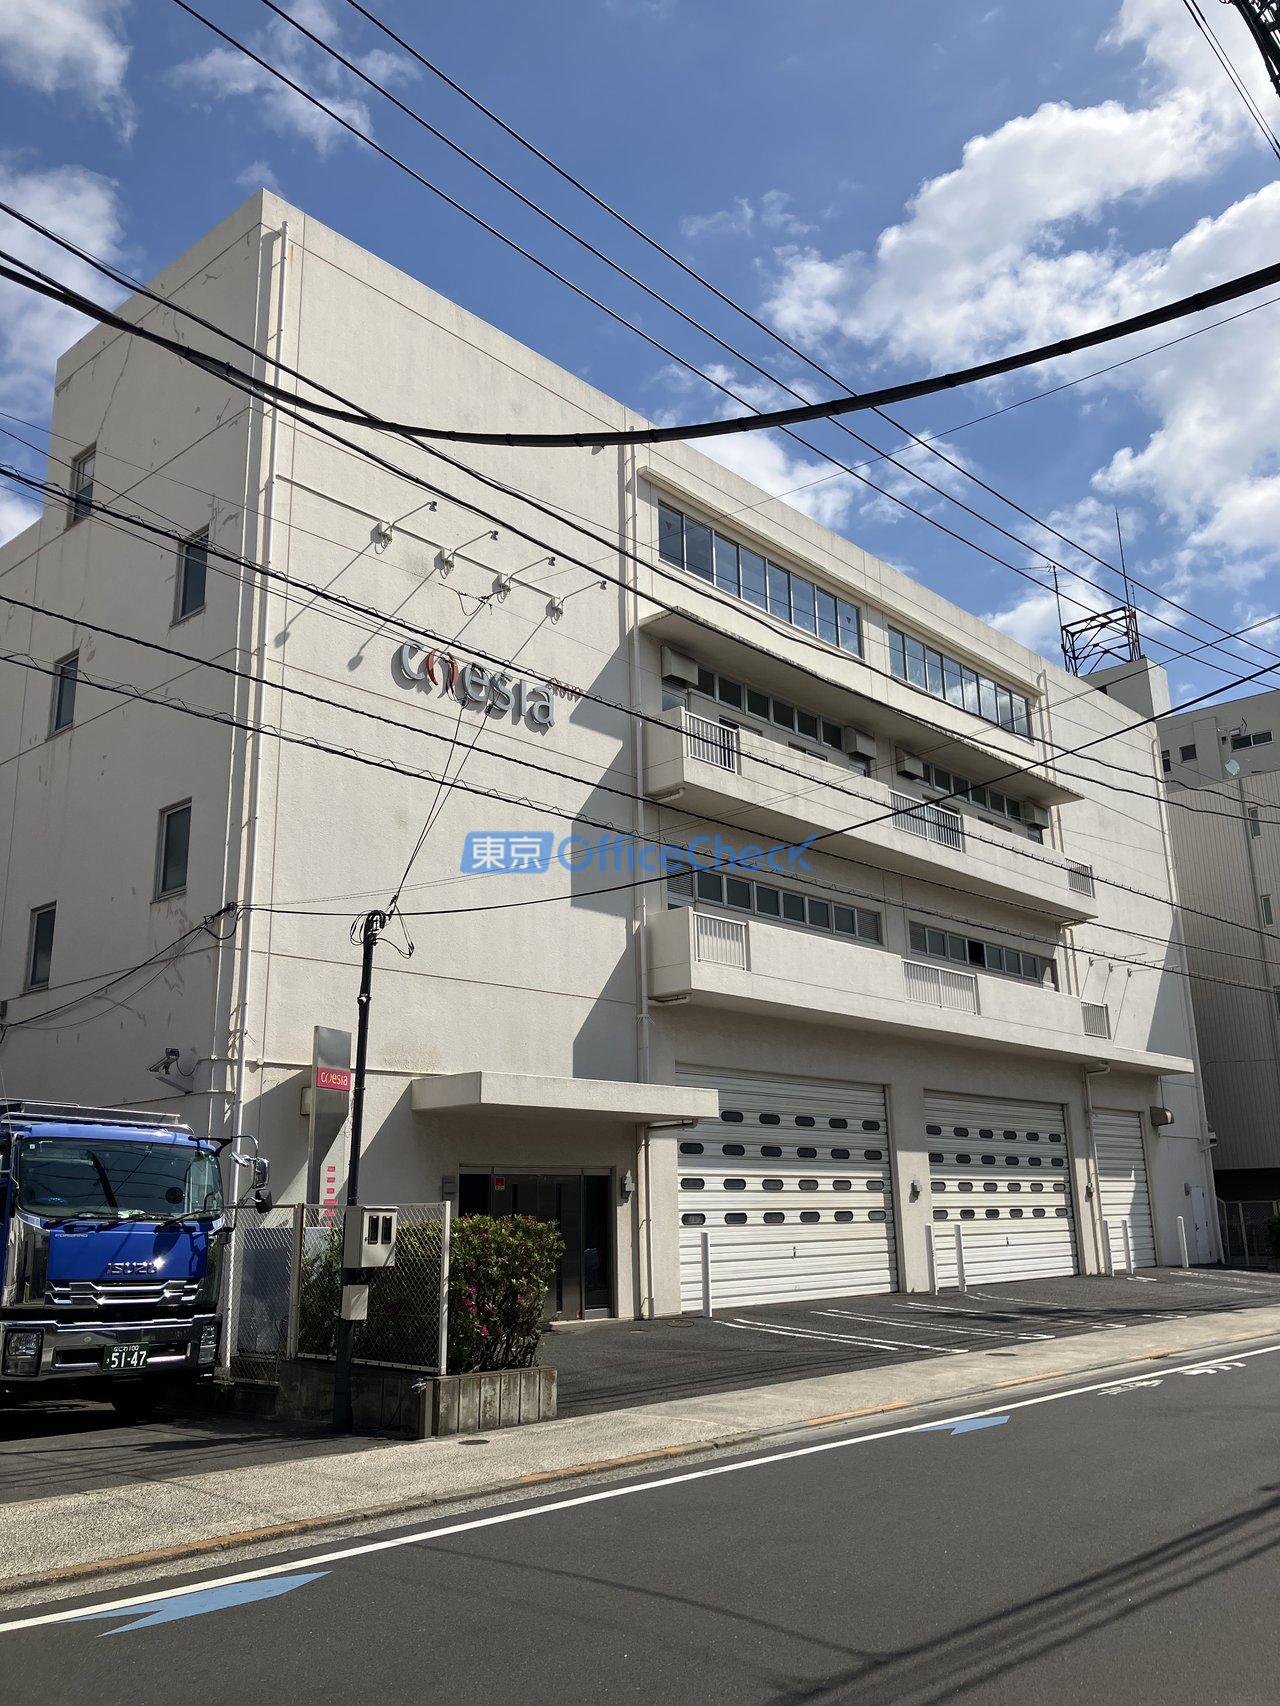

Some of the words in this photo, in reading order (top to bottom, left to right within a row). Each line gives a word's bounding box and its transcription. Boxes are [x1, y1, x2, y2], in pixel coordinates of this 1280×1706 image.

[320, 1071, 348, 1086] coesia
[106, 1261, 158, 1275] ISUZU
[110, 1350, 147, 1368] 51-47
